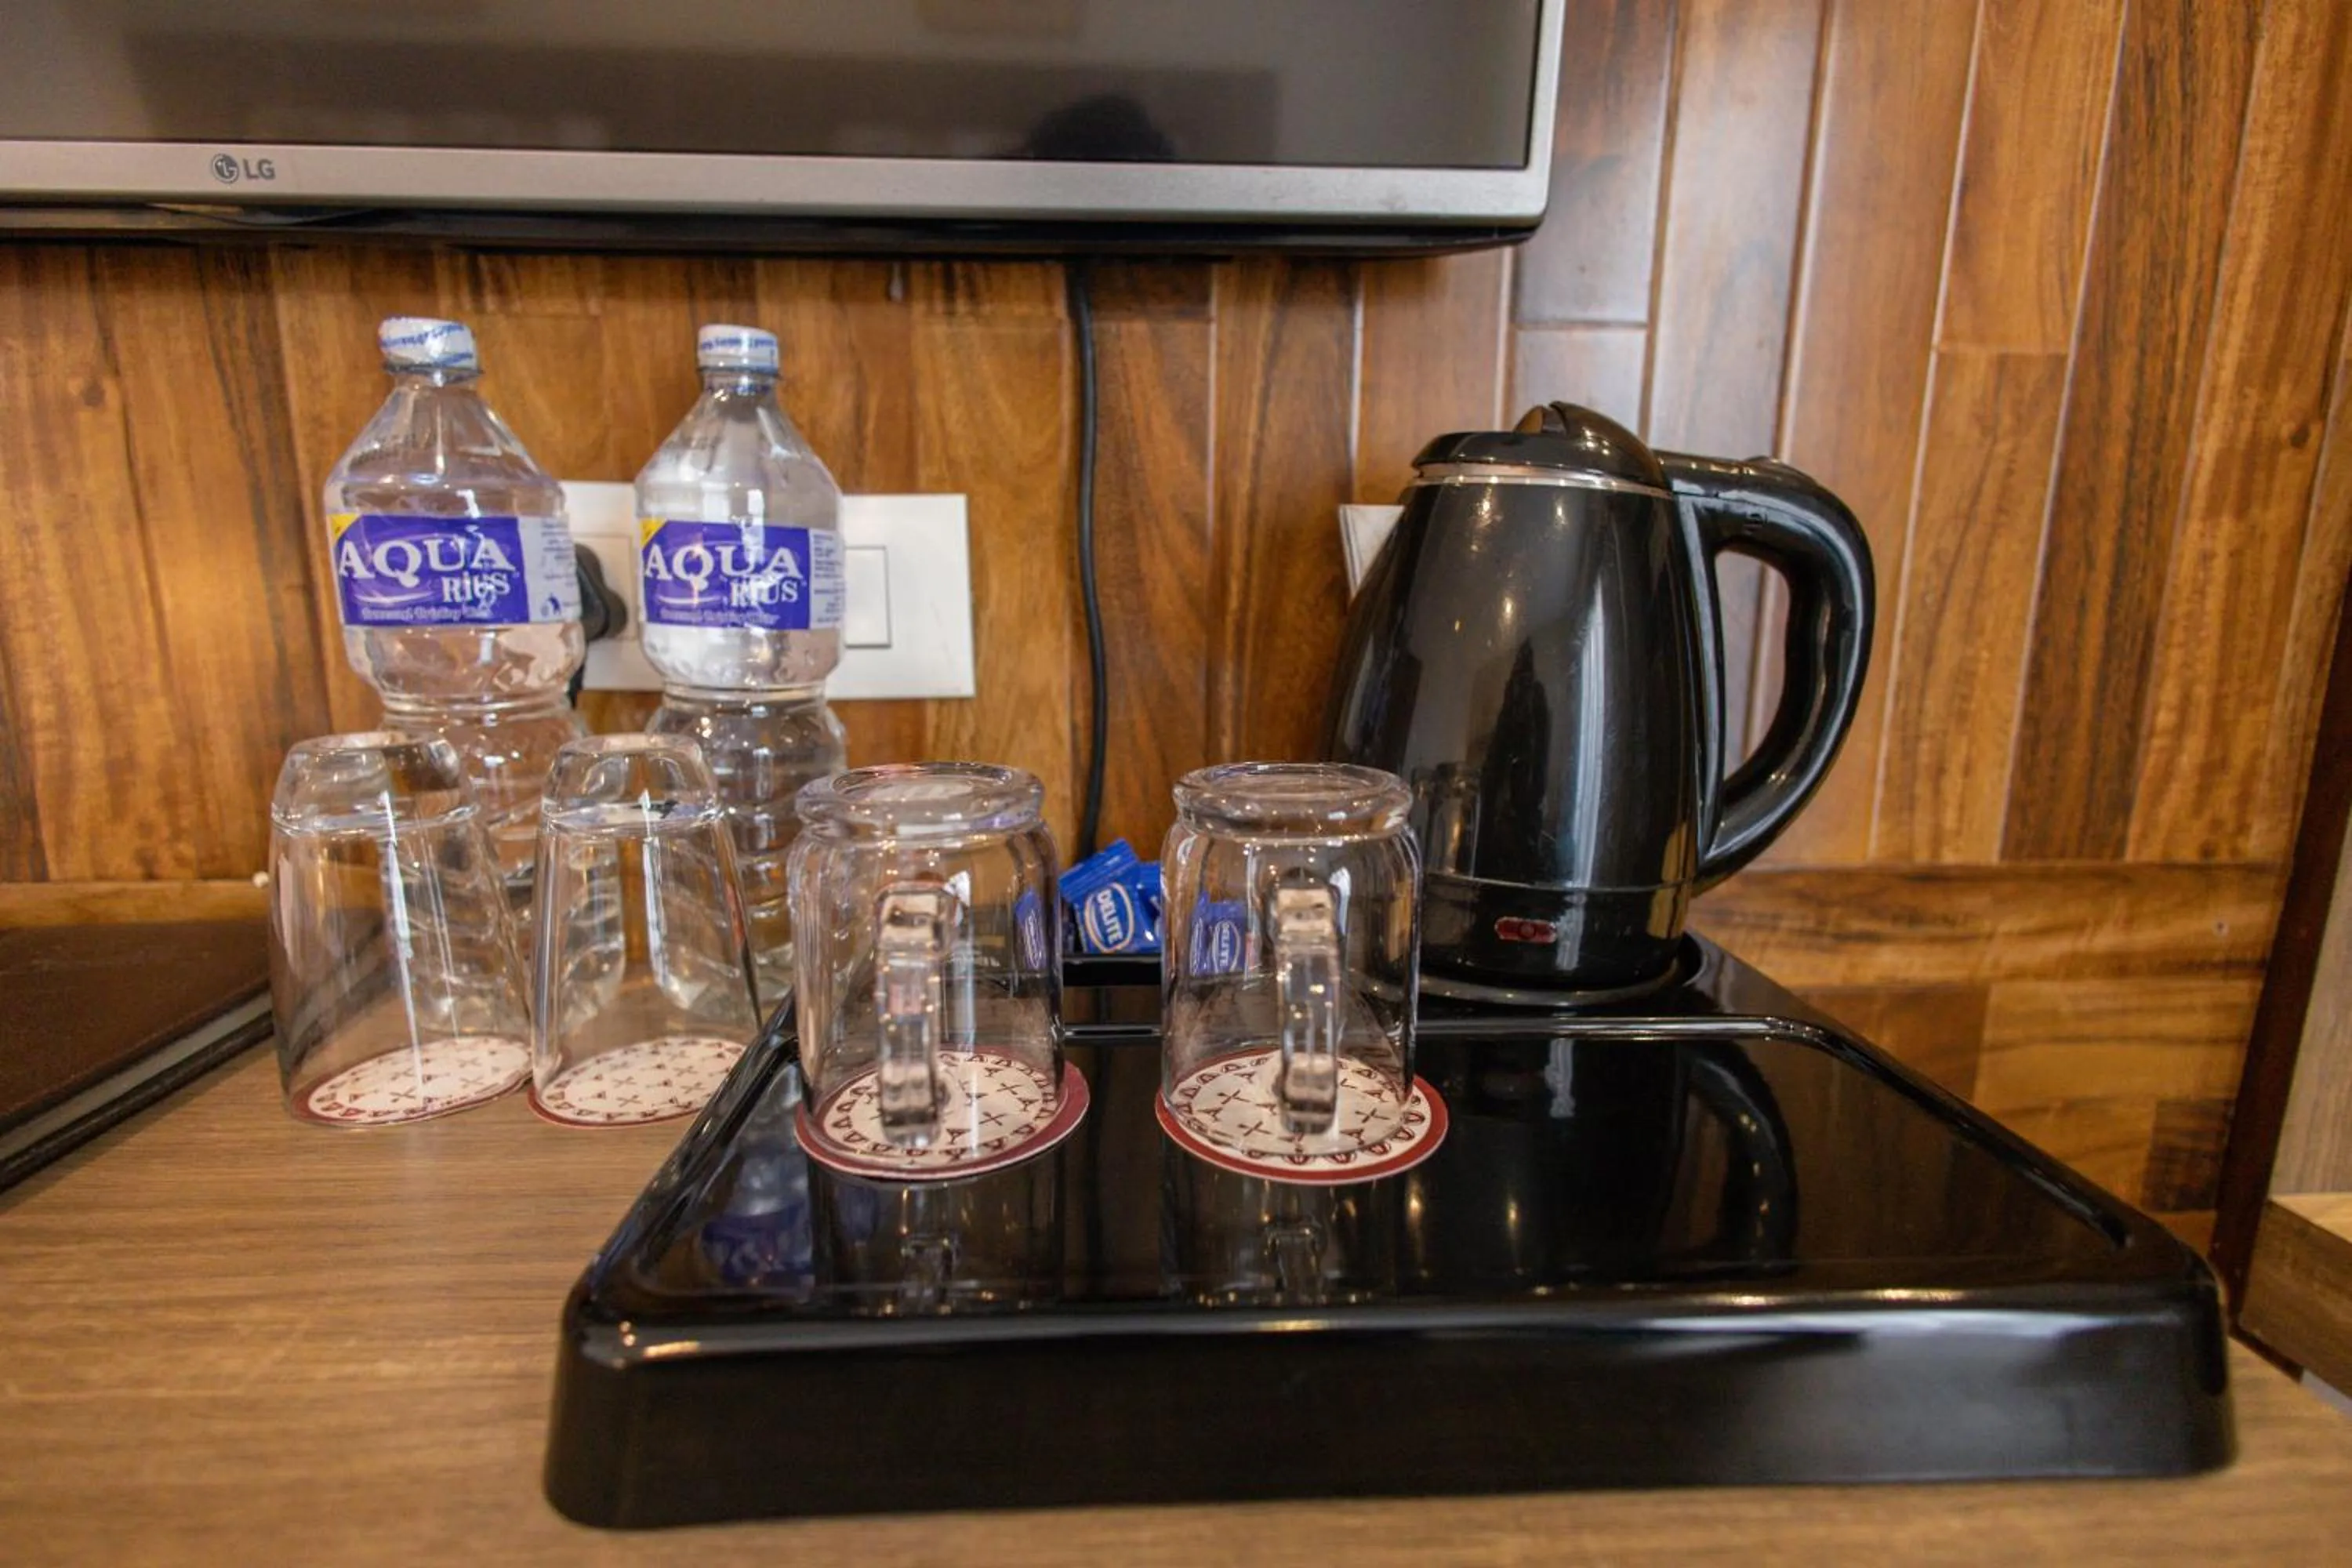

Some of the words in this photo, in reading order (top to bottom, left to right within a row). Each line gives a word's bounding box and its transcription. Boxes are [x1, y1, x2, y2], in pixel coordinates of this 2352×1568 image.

[242, 158, 276, 180] LG
[339, 538, 515, 587] AQUA
[644, 543, 803, 591] AQUA
[1098, 889, 1123, 945] DELITE
